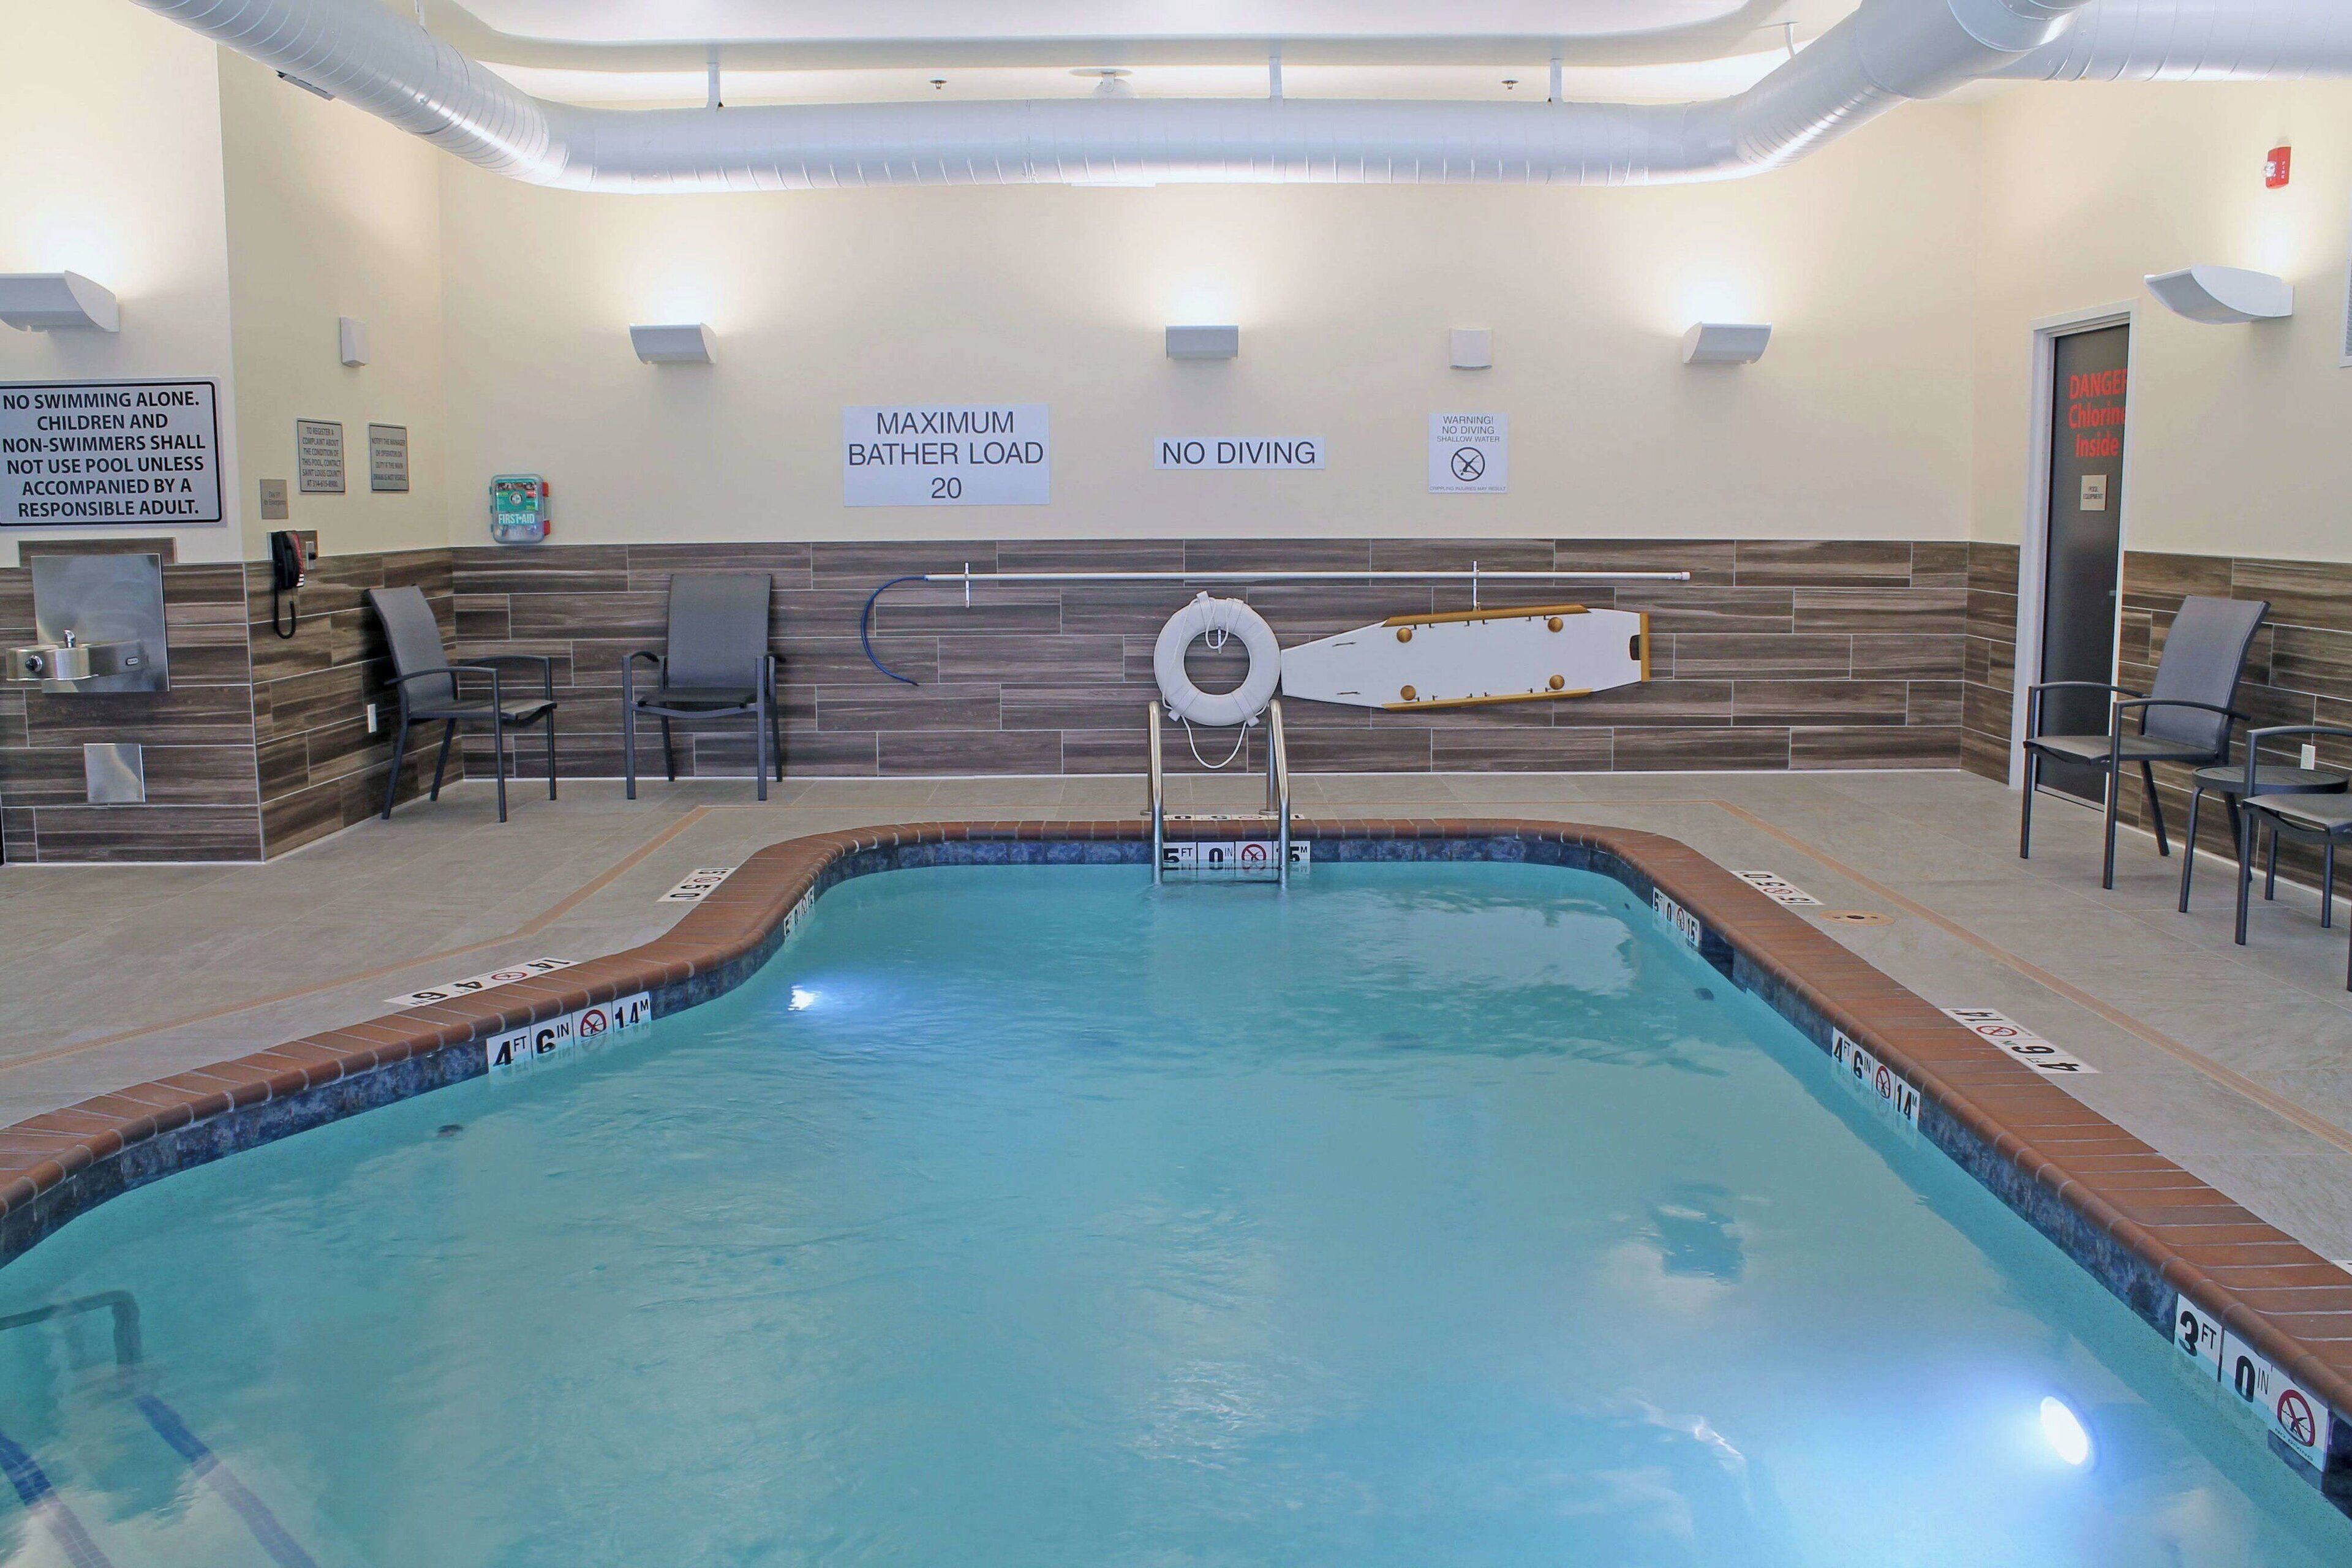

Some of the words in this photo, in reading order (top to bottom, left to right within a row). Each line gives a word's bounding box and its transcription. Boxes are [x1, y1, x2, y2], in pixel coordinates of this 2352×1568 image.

[4, 394, 29, 409] NO
[35, 393, 131, 409] SWIMMING
[137, 391, 200, 407] ALONE.
[37, 415, 124, 431] CHILDREN
[130, 413, 168, 428] AND
[877, 411, 1014, 434] MAXIMUM
[1443, 416, 1493, 424] WARNING!
[1442, 426, 1457, 434] NO
[1461, 426, 1494, 434] DIVING
[3, 436, 145, 453] NON-SWIMMERS
[151, 435, 205, 450] SHALL
[1163, 442, 1205, 464] NO
[1218, 441, 1315, 464] DIVING
[2075, 431, 2119, 457] Inside
[849, 443, 959, 466] BATHER
[970, 442, 1044, 464] LOAD
[7, 460, 43, 474] NOT
[48, 459, 80, 473] USE
[86, 458, 134, 473] POOL
[138, 456, 203, 472] UNLESS
[23, 479, 149, 496] ACCOMPANIED
[154, 479, 175, 493] BY
[181, 478, 192, 492] A
[931, 477, 962, 499] 20
[18, 501, 134, 518] RESPONSIBLE
[139, 500, 198, 514] ADULT.
[1164, 848, 1180, 863] 5
[1181, 848, 1193, 857] FT
[1209, 848, 1223, 862] 0
[1225, 848, 1233, 857] IN
[640, 998, 649, 1011] M
[493, 1041, 514, 1066] 4
[514, 1036, 527, 1052] FT
[536, 1029, 556, 1054] 6
[557, 1022, 570, 1038] IN
[1834, 1036, 1842, 1063] 4
[1844, 1041, 1850, 1056] FT
[1853, 1050, 1863, 1079] 6
[1864, 1057, 1871, 1073] IN
[2037, 1063, 2079, 1072] 4
[2179, 1311, 2198, 1357] 3
[2201, 1324, 2217, 1349] FT
[2234, 1355, 2255, 1403] 0
[2258, 1367, 2269, 1395] IN
